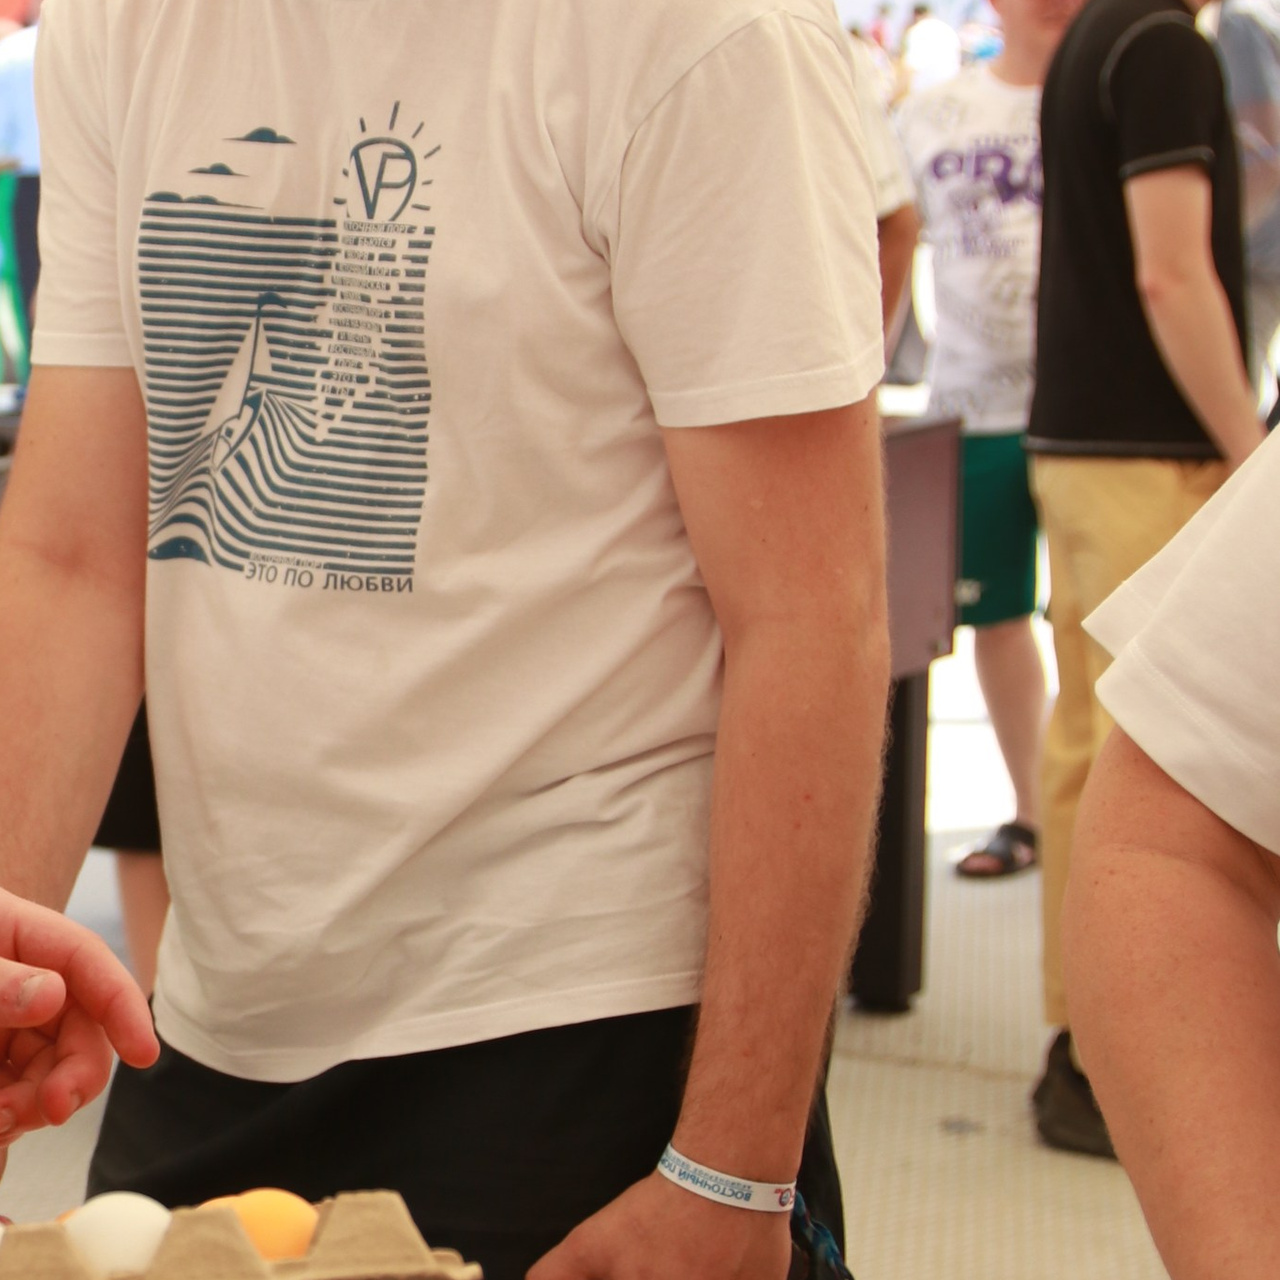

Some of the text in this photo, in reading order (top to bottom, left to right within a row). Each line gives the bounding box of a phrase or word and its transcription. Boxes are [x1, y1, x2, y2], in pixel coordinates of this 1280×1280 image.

[245, 561, 413, 593] ЭТО ПО ЛЮБВИ
[677, 1167, 752, 1202] ВОСТОЧНЫЙ
